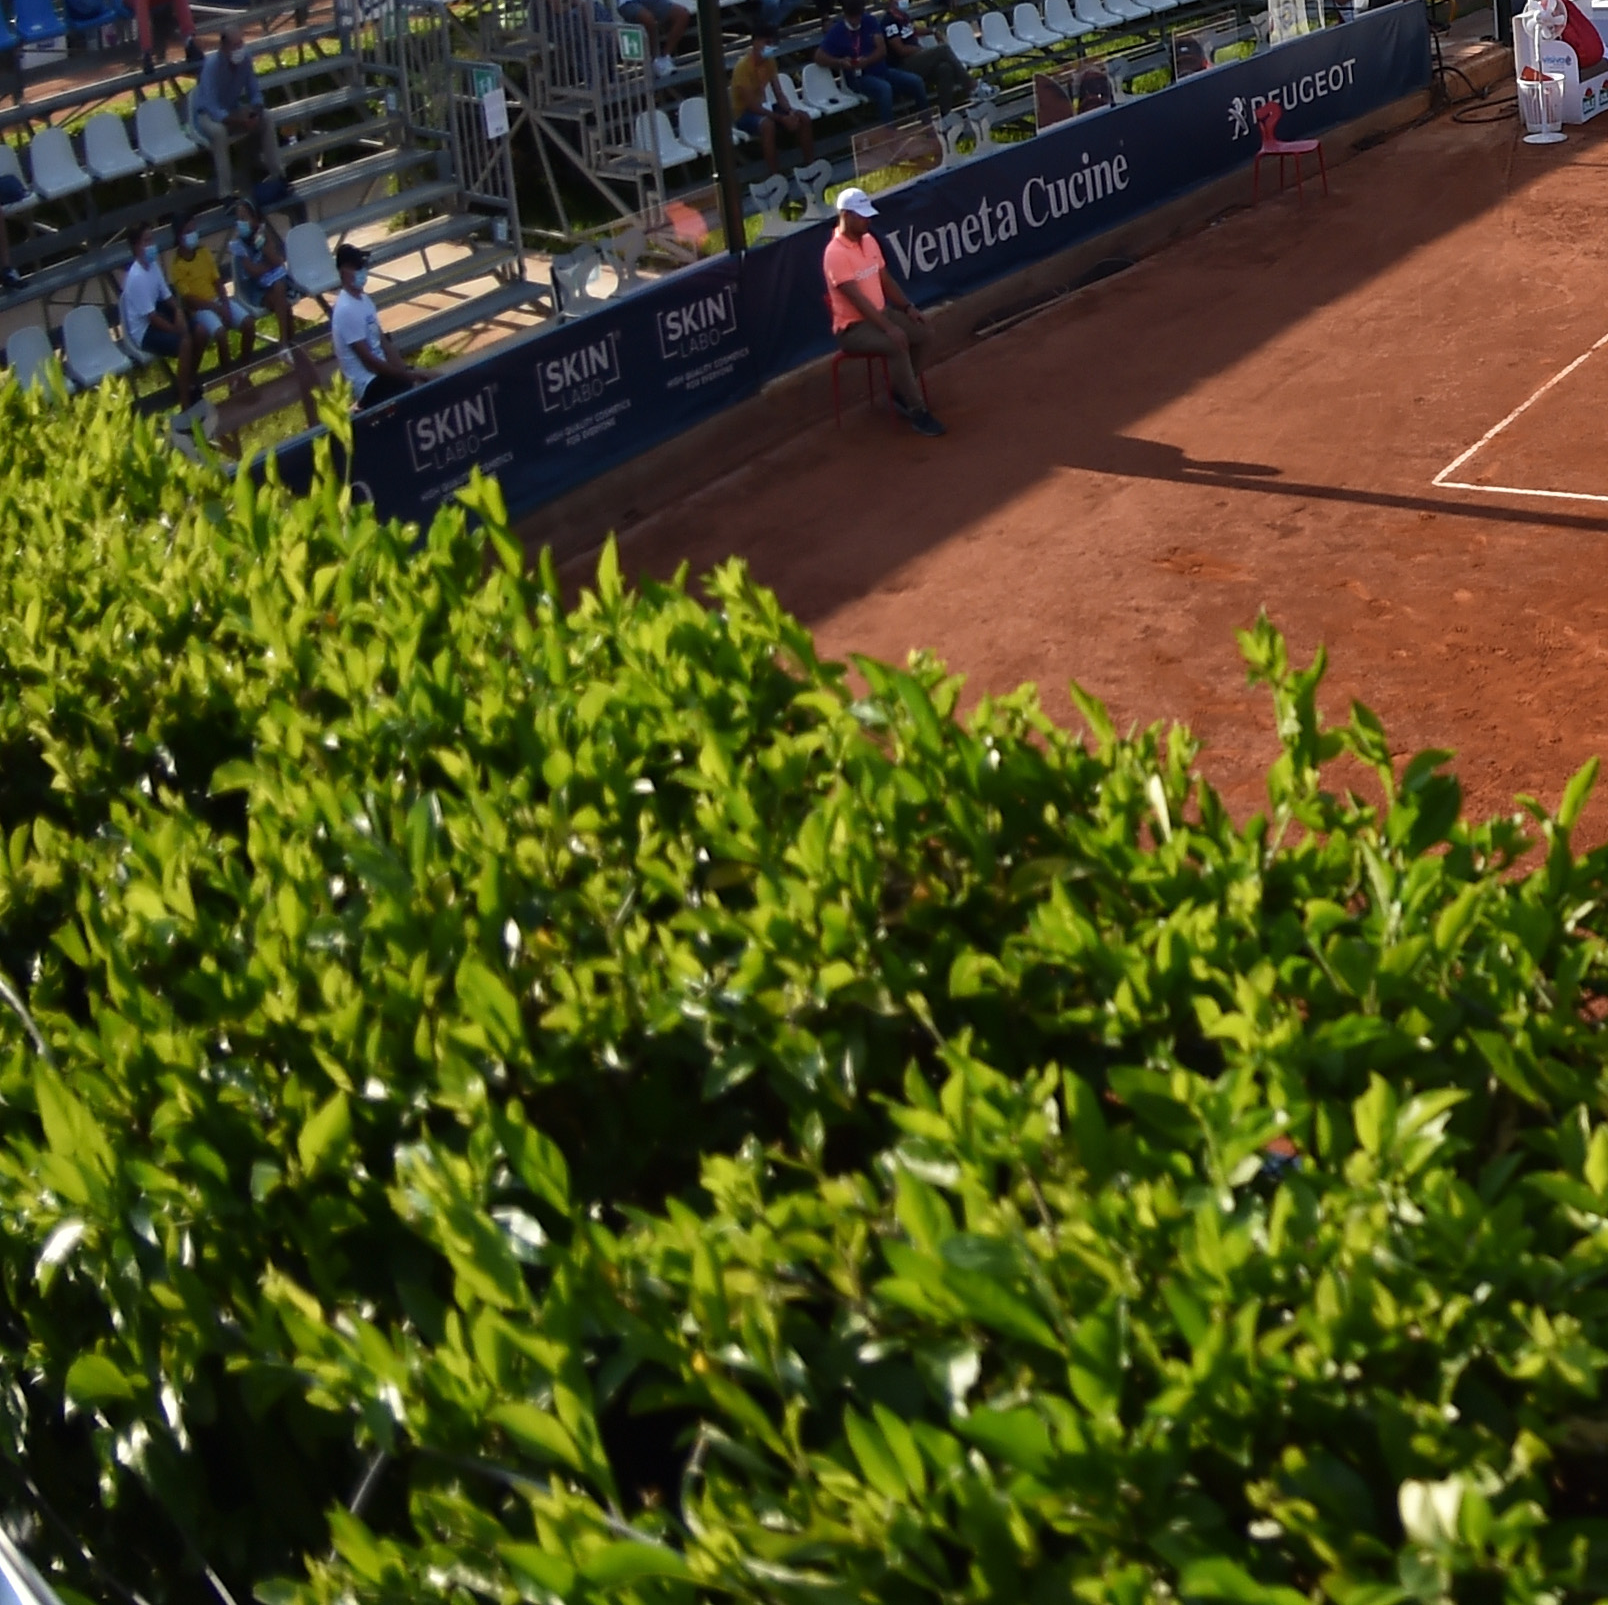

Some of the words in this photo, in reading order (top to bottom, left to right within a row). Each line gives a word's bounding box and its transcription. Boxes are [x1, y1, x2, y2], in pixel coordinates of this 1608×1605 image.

[885, 196, 1018, 281] Veneta
[1021, 151, 1130, 229] Cucine
[665, 292, 728, 343] SKIN
[545, 338, 611, 394] SKIN
[680, 329, 722, 359] LABO
[562, 379, 605, 411] LABO
[415, 393, 489, 454] SKIN
[433, 434, 482, 470] LABO
